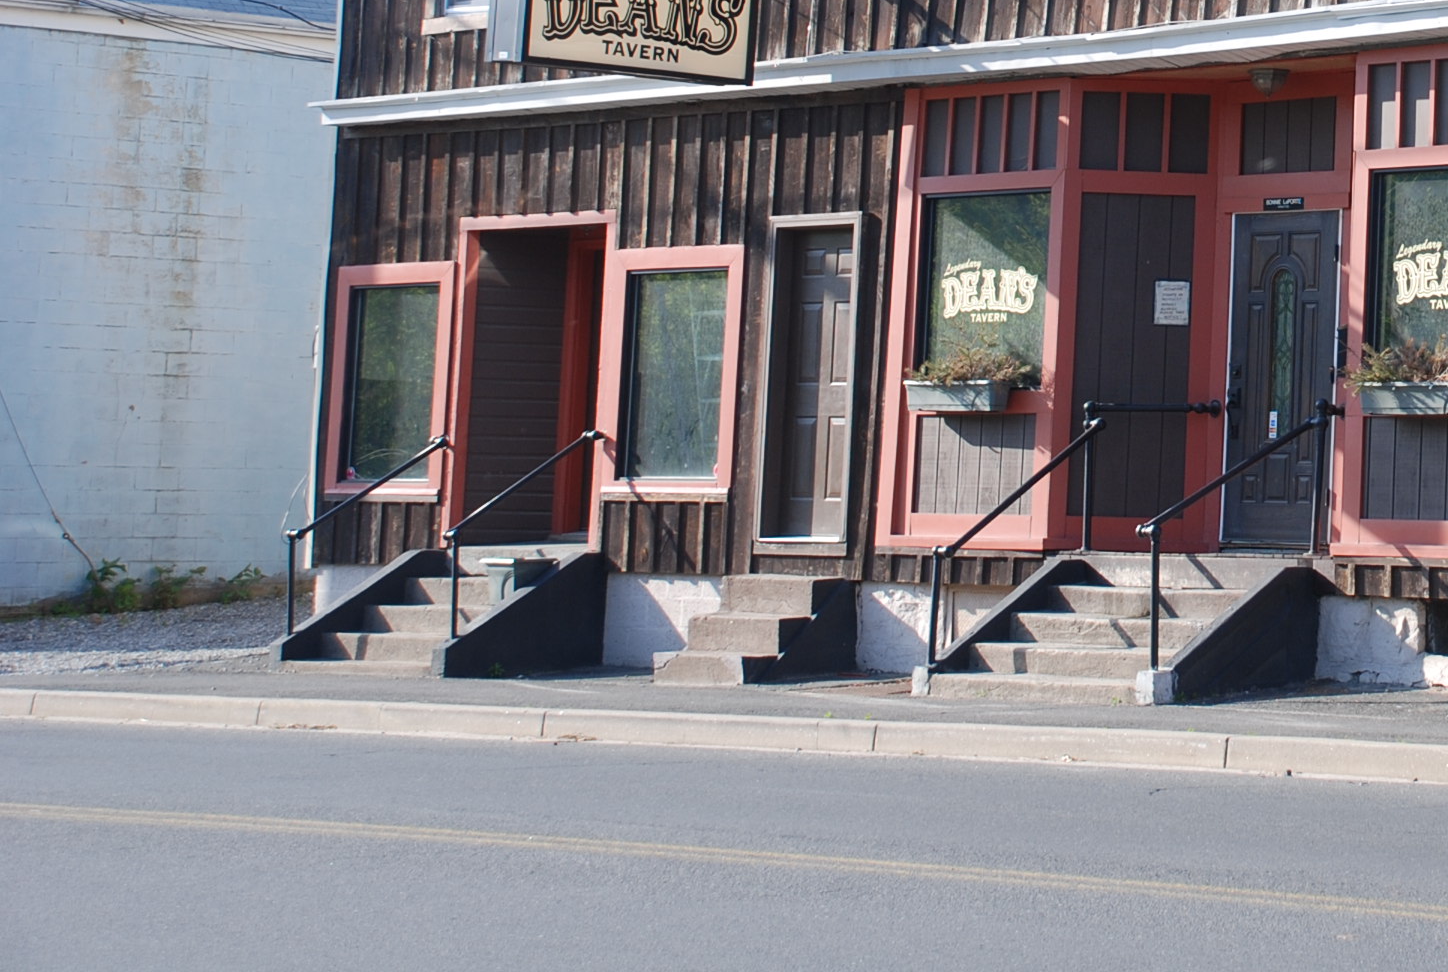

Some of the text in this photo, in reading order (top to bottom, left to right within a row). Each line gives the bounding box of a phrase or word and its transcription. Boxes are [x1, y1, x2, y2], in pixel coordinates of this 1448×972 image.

[602, 39, 680, 63] TAVERN
[1396, 238, 1442, 259] Legendary
[941, 266, 1038, 319] DEAN'S
[970, 313, 1008, 323] TAVERN
